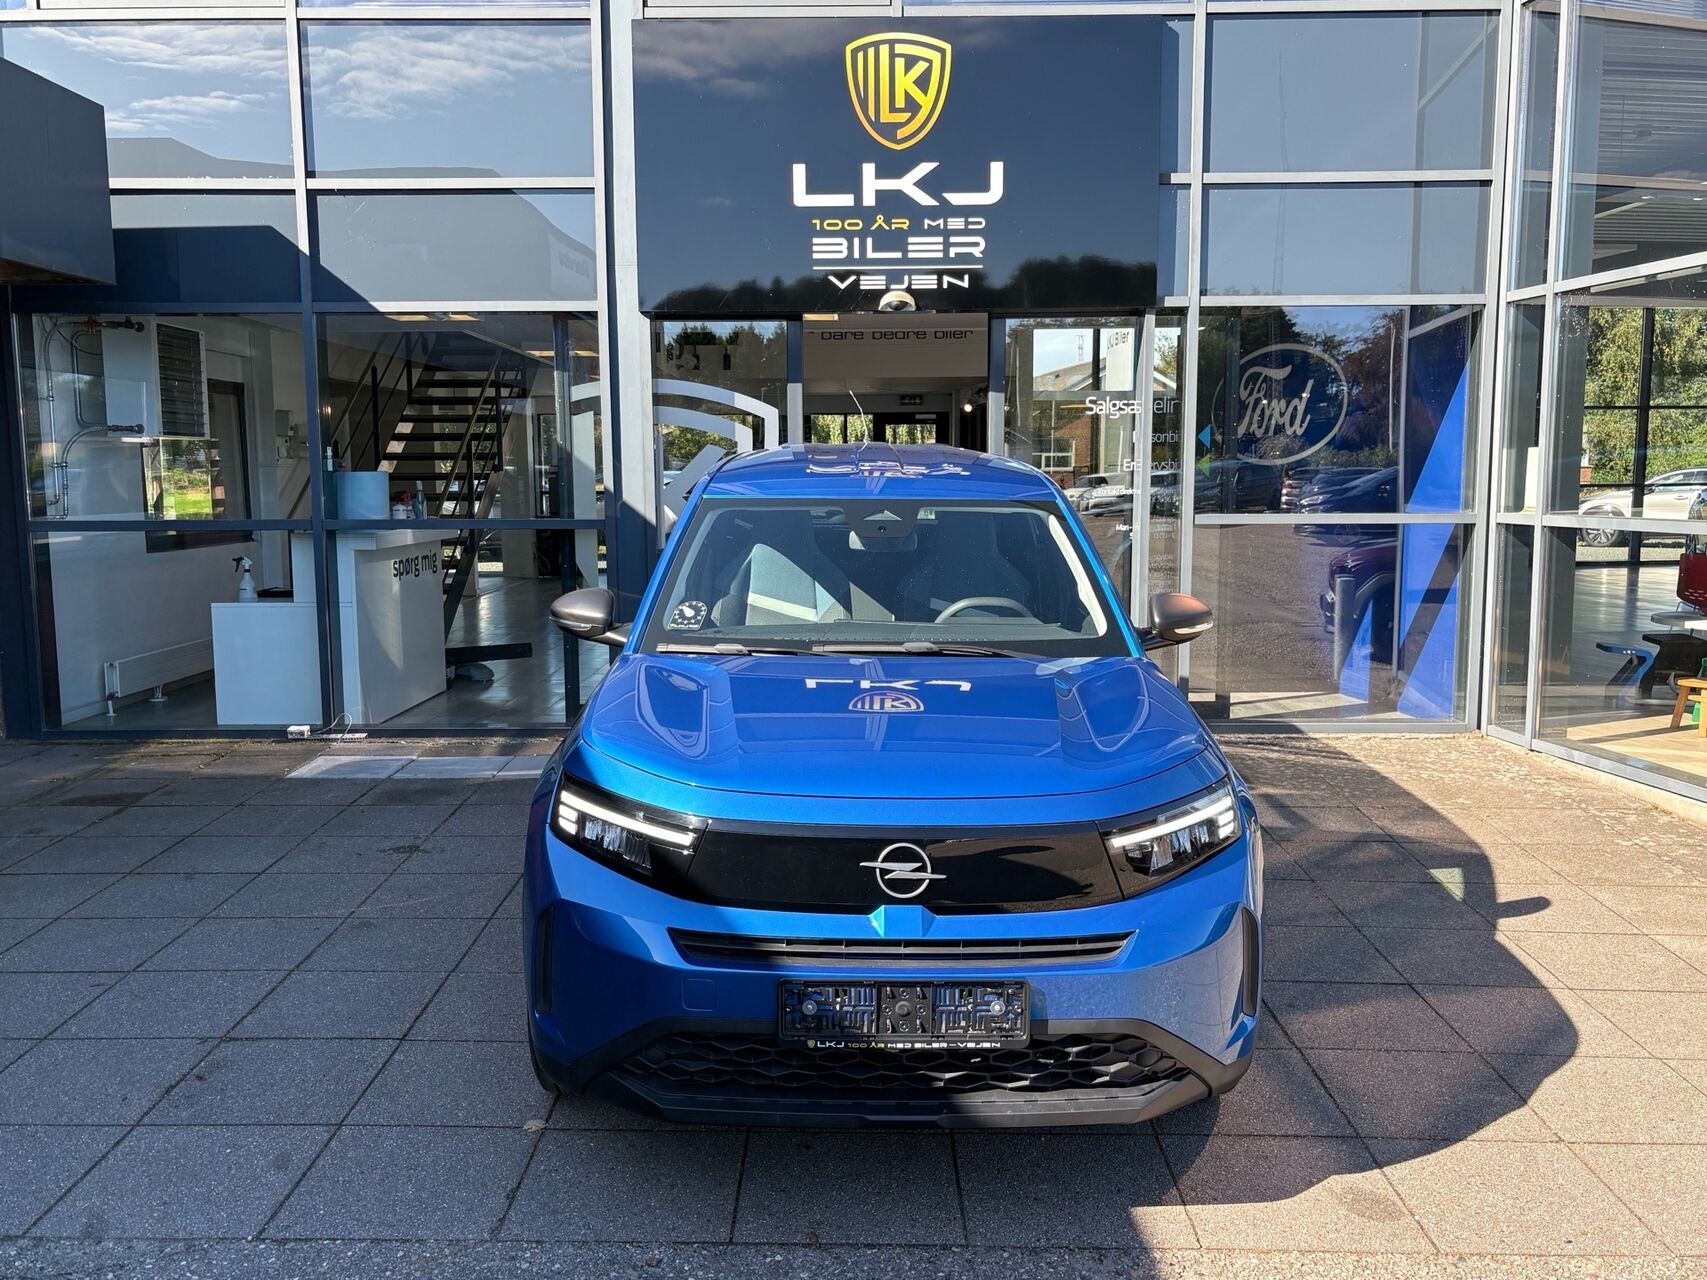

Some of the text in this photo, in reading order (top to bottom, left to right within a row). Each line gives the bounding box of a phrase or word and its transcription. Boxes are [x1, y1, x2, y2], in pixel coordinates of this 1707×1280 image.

[792, 161, 1004, 207] LKJ
[812, 214, 986, 230] 100 ÅR MED
[812, 236, 986, 259] BILER
[828, 274, 969, 290] VEJEN
[1236, 364, 1315, 439] Ford
[393, 548, 438, 581] spørg mig
